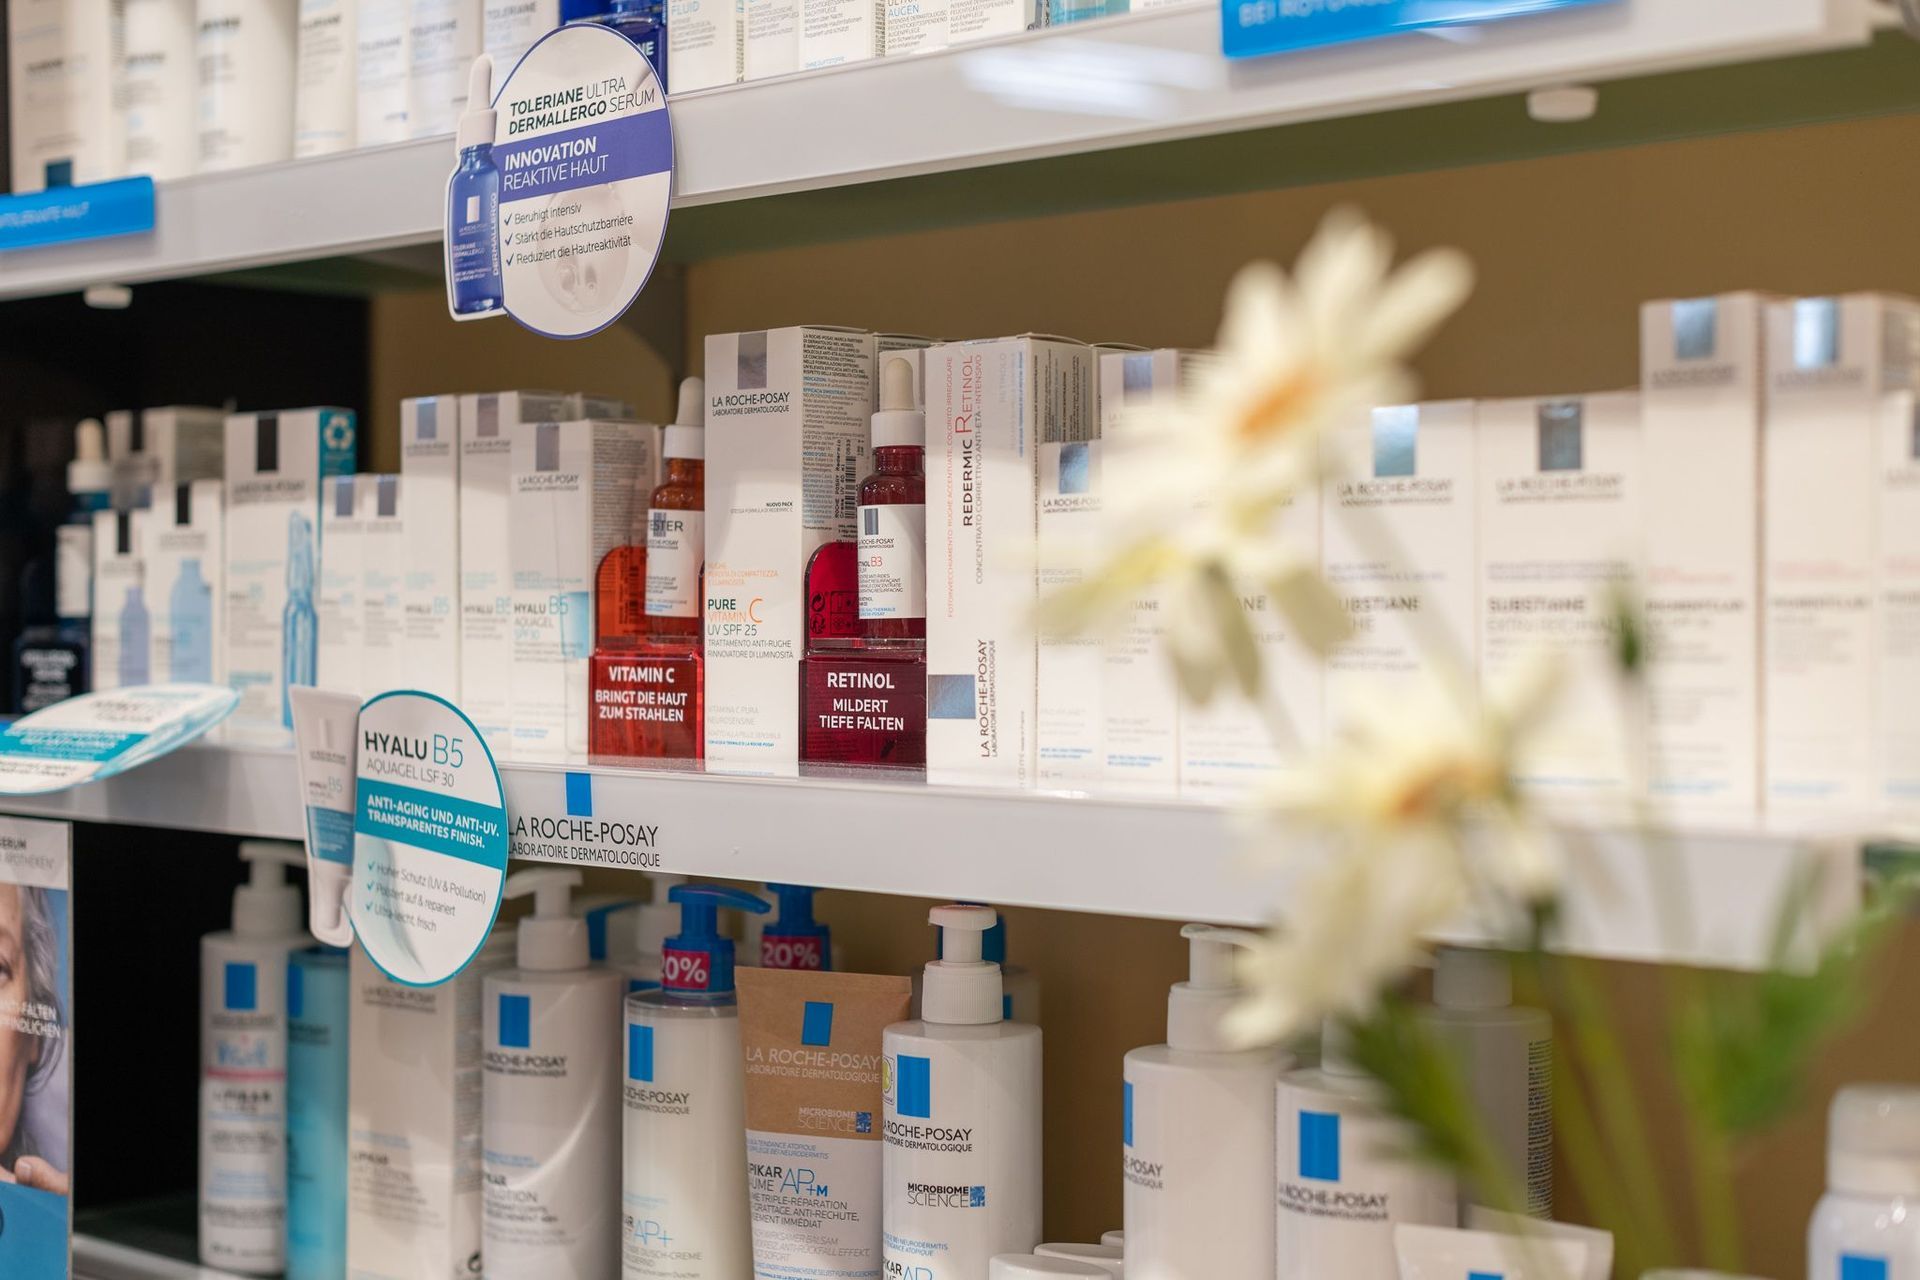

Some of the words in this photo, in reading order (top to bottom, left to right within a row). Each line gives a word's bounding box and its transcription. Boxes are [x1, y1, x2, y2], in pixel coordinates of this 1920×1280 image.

[888, 4, 919, 17] AUGEN
[510, 87, 584, 117] TOLERIANE
[586, 76, 626, 100] ULTRA
[509, 101, 607, 135] DERMALLERGO
[609, 88, 656, 114] SERUM
[505, 136, 597, 171] INNOVATION
[504, 165, 569, 191] REAKTIVE
[570, 155, 608, 176] HAUT
[514, 210, 548, 226] Beruhigt
[550, 203, 582, 220] intensiv
[515, 231, 539, 245] Stärkt
[540, 228, 553, 242] die
[554, 215, 634, 240] Hautschutzbarriere
[517, 248, 556, 265] Reduziert
[558, 245, 570, 258] die
[570, 235, 632, 256] Hautreaktivität
[712, 396, 723, 408] LA
[726, 392, 790, 406] ROCHE-POSAY
[955, 355, 973, 434] RETINOL
[712, 408, 743, 416] LABORATOIRE
[744, 404, 789, 415] DERMATOLOGIQUE
[963, 439, 972, 526] REDERMIC
[1043, 500, 1052, 508] LA
[871, 556, 883, 566] B3
[514, 602, 546, 614] HYALU
[549, 595, 568, 615] B5
[708, 599, 736, 610] PURE
[749, 598, 763, 623] C
[708, 611, 746, 622] VITAMIN
[708, 624, 722, 636] UV
[723, 624, 742, 636] SPF
[744, 624, 758, 636] 25
[708, 640, 751, 648] TRATTAMENTO
[752, 640, 792, 648] ANTI-RUGHE
[708, 650, 749, 658] RINNOVATORE
[609, 666, 662, 683] VITAMIN
[666, 668, 675, 683] C
[827, 672, 895, 688] RETINOL
[978, 640, 988, 736] ROCHE-POSAY
[595, 689, 636, 703] BRINGT
[638, 692, 655, 704] DIE
[657, 693, 687, 706] HAUT
[833, 698, 888, 713] MILDERT
[600, 707, 623, 718] ZUM
[626, 708, 684, 722] STRAHLEN
[819, 715, 854, 729] TIEFE
[857, 716, 904, 730] FALTEN
[364, 731, 428, 760] HYALU
[433, 734, 464, 769] B5
[981, 740, 990, 757] LA
[367, 757, 419, 779] AQUAGEL
[420, 766, 440, 784] LSF
[441, 773, 455, 788] 30
[367, 794, 429, 820] ANTI-AGING
[431, 808, 454, 825] UND
[455, 814, 500, 837] ANTI-UV.
[368, 810, 449, 840] TRANSPARENTES
[451, 830, 486, 849] FINISH.
[531, 817, 658, 848] ROCHE-POSAY
[508, 843, 568, 859] LABORATOIRE
[570, 847, 660, 868] DERMATOLOGIQUE
[400, 868, 426, 887] Schutz
[427, 874, 441, 891] (UV
[442, 879, 449, 892] &
[450, 882, 487, 904] Pollution)
[425, 898, 456, 918] repariert
[417, 916, 437, 933] frisch
[762, 942, 820, 967] 20%
[746, 1047, 764, 1062] LA
[768, 1048, 880, 1070] ROCHE-POSAY
[746, 1064, 800, 1078] LABORATOIRE
[802, 1069, 880, 1083] DERMATOLOGIQUE
[799, 1107, 856, 1118] MICROBIOME
[798, 1116, 856, 1132] SCIENCE
[889, 1121, 972, 1141] ROCHE-POSAY
[905, 1140, 972, 1153] DERMATOLOGIQUE
[908, 1183, 969, 1195] MICROBIOME
[908, 1191, 968, 1208] SCIENCE
[781, 1217, 822, 1228] IMMÉDIAT
[794, 1208, 859, 1221] ANTI-RECHUTE,
